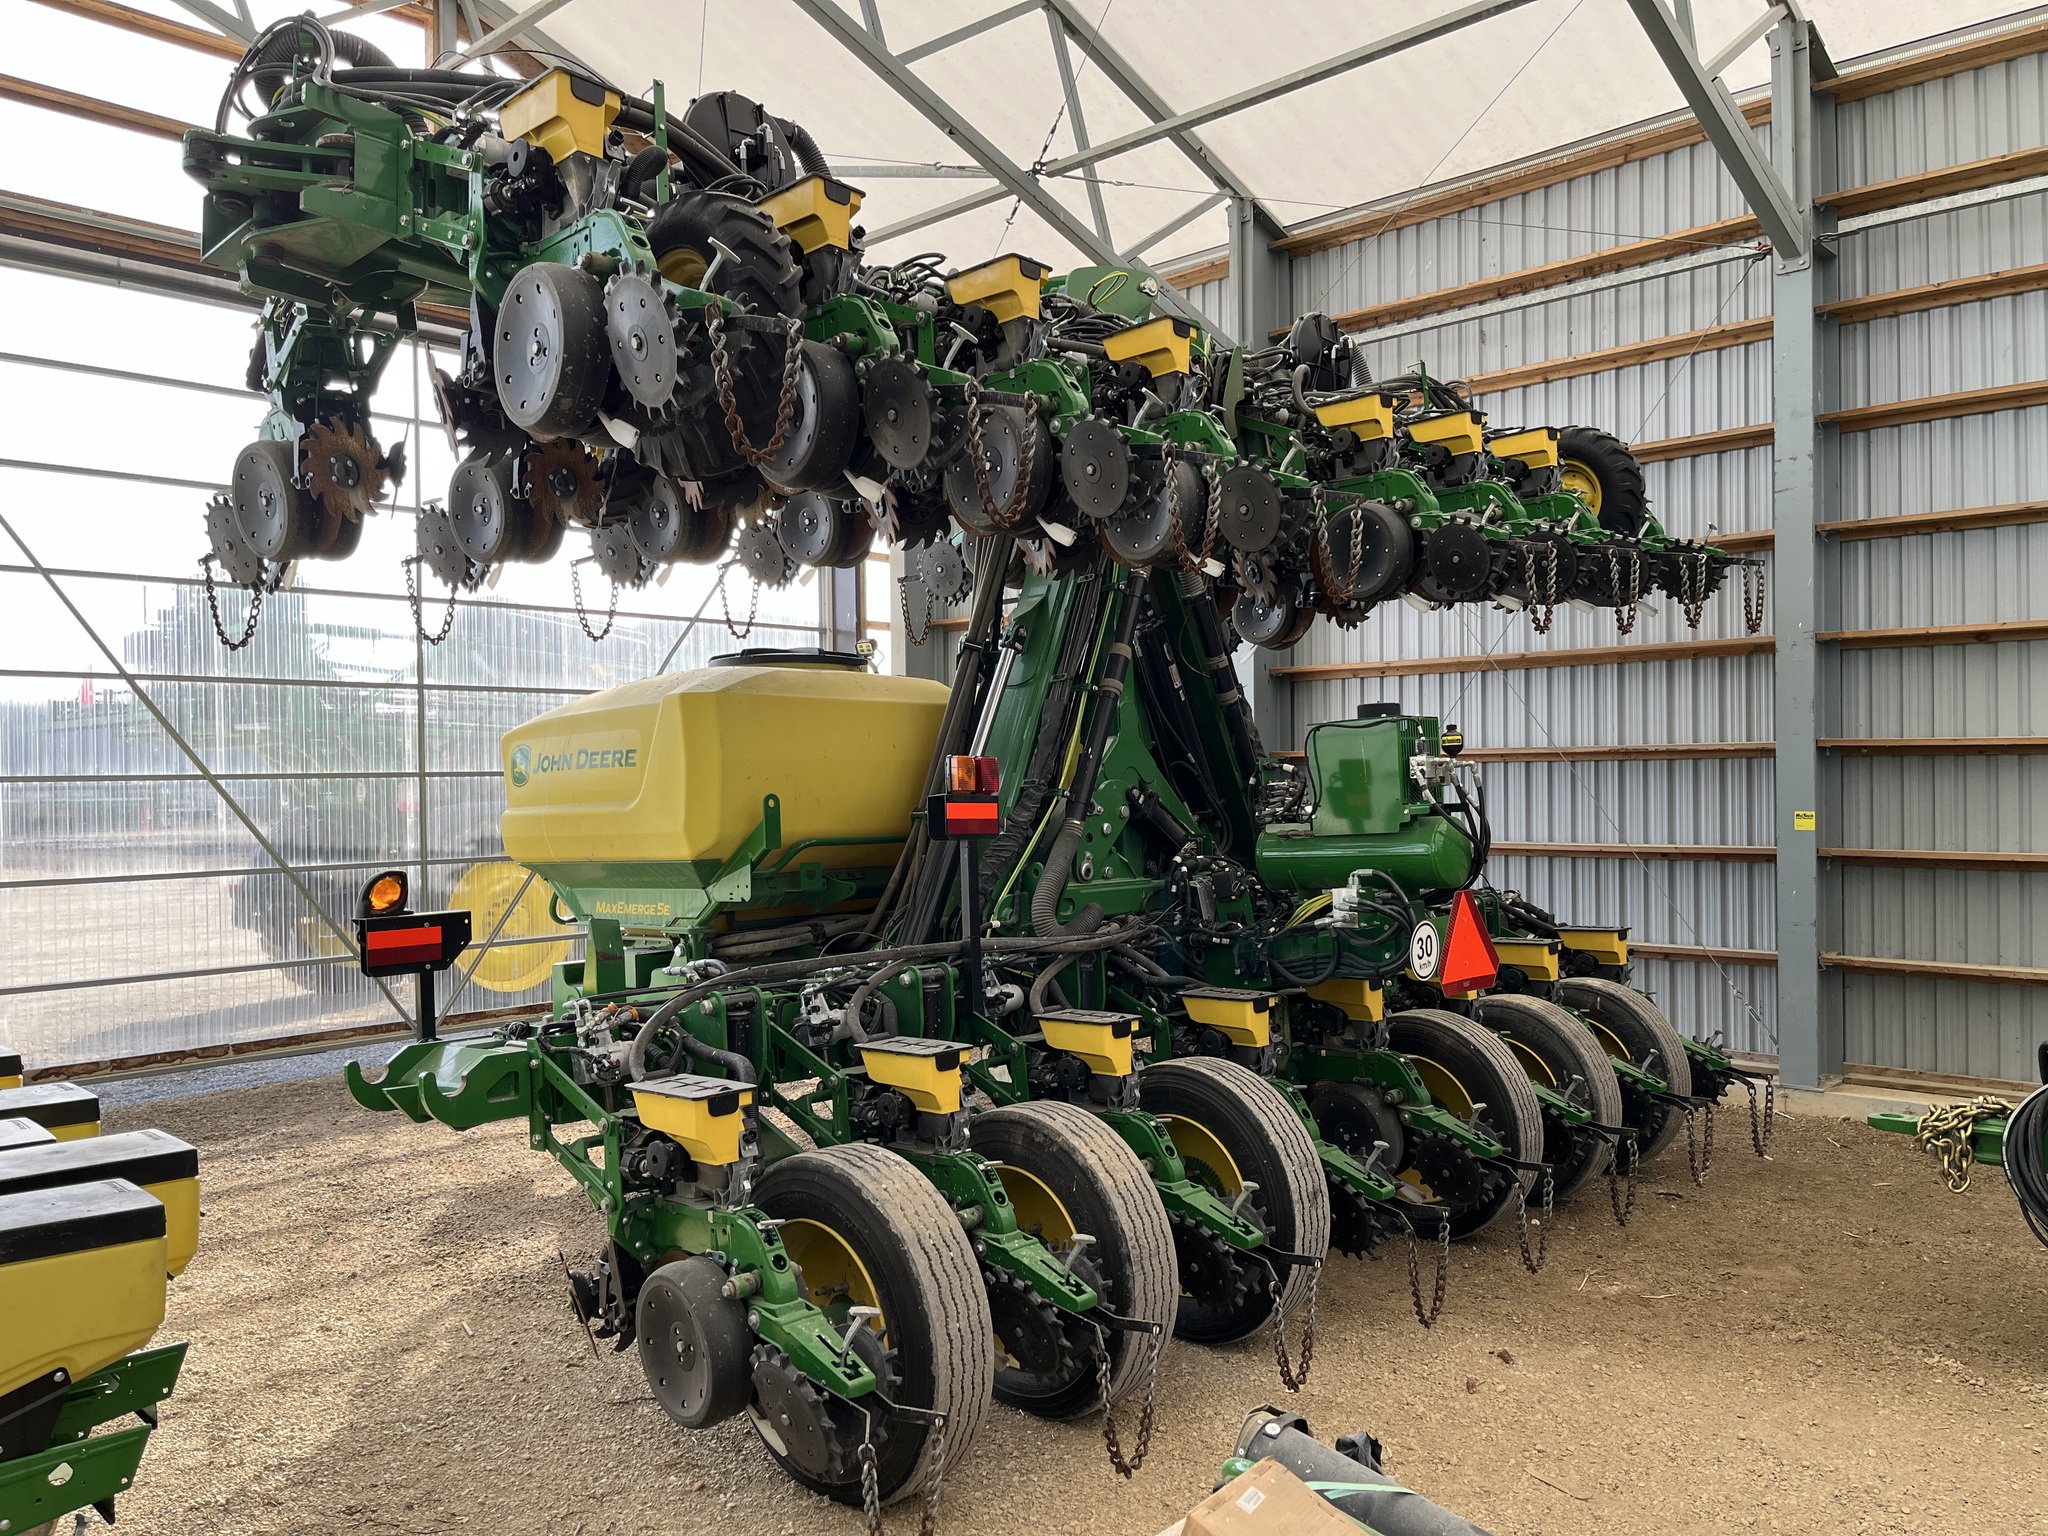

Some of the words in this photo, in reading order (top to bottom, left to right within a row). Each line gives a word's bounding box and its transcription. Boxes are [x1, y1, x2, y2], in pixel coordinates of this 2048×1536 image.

[533, 752, 572, 774] JOHN
[576, 748, 637, 770] DEERE
[1417, 935, 1432, 960] 30
[1420, 960, 1431, 970] km/h
